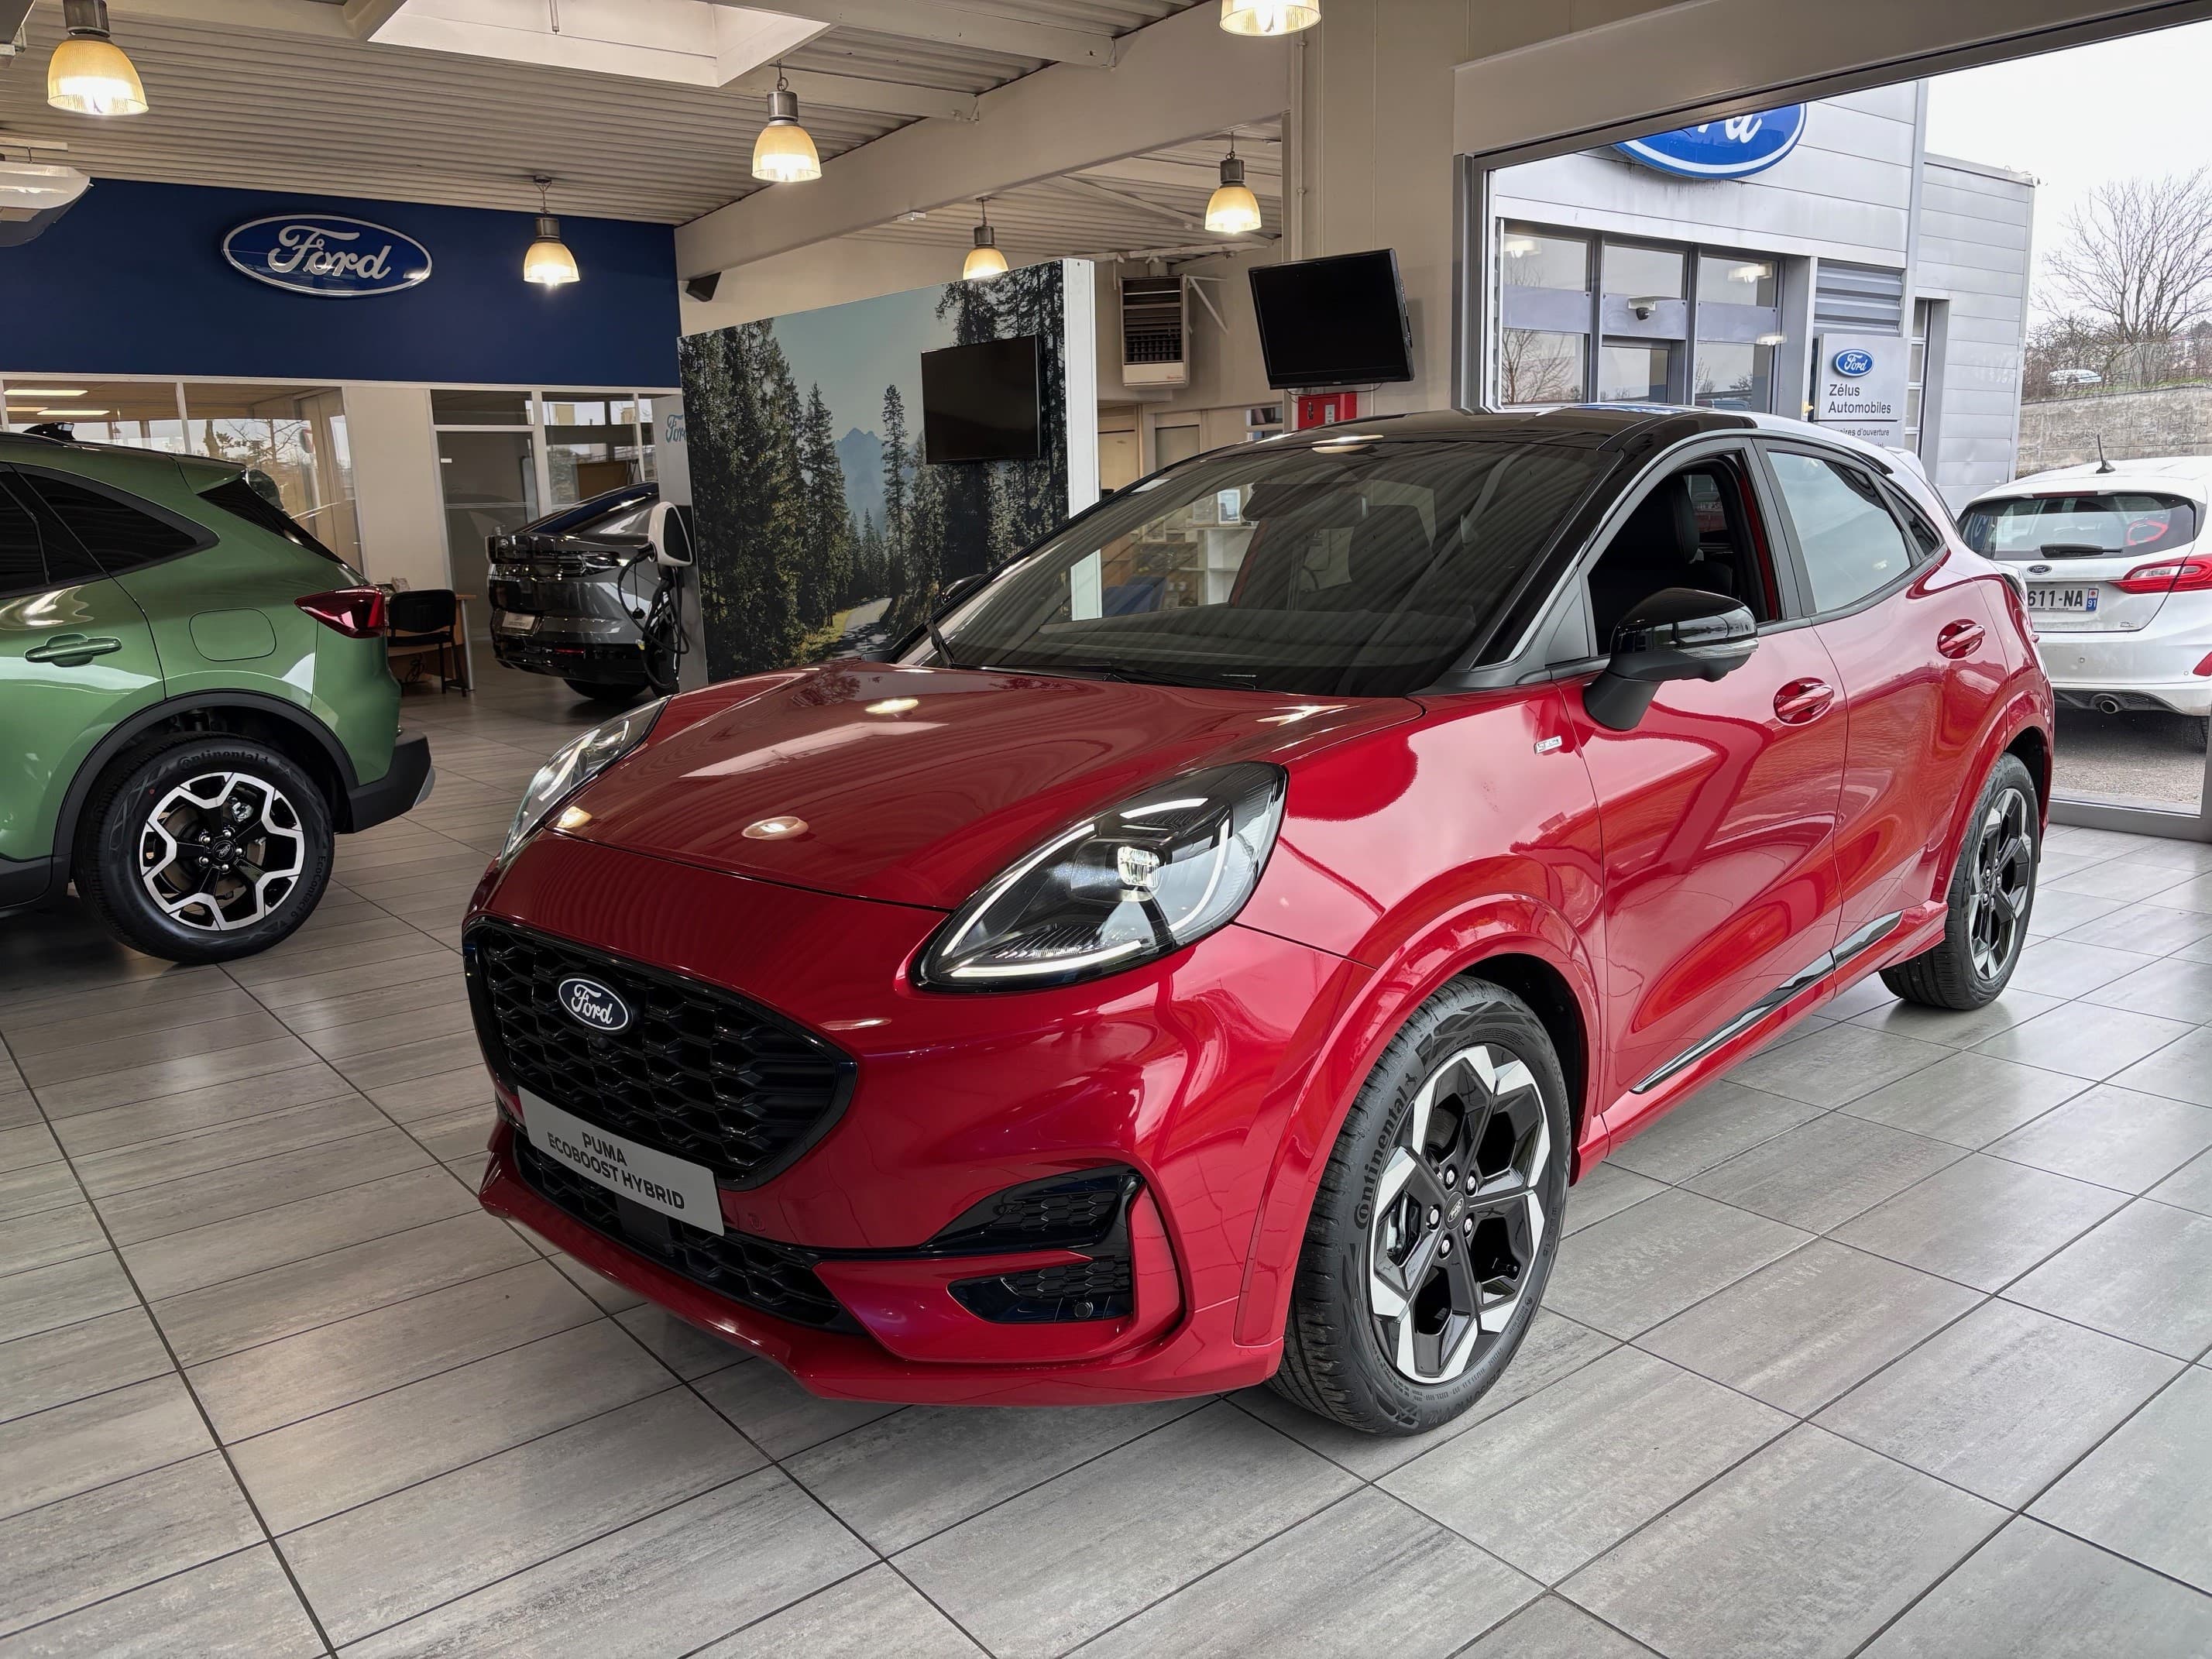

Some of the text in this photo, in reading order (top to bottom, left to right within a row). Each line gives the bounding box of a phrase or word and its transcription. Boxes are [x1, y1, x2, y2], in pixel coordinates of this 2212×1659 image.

[267, 225, 392, 280] Ford
[1844, 353, 1868, 371] Ford
[1828, 401, 1891, 414] Automobiles
[1829, 383, 1860, 397] Zélus
[1856, 428, 1890, 437] d'ouverture
[2028, 590, 2097, 608] 611-NA 91
[296, 855, 326, 912] EcoContact
[571, 983, 613, 1025] Ford
[582, 1131, 627, 1166] PUMA
[1354, 1086, 1410, 1230] Continental
[547, 1131, 685, 1209] ECOBOOST HYBRID
